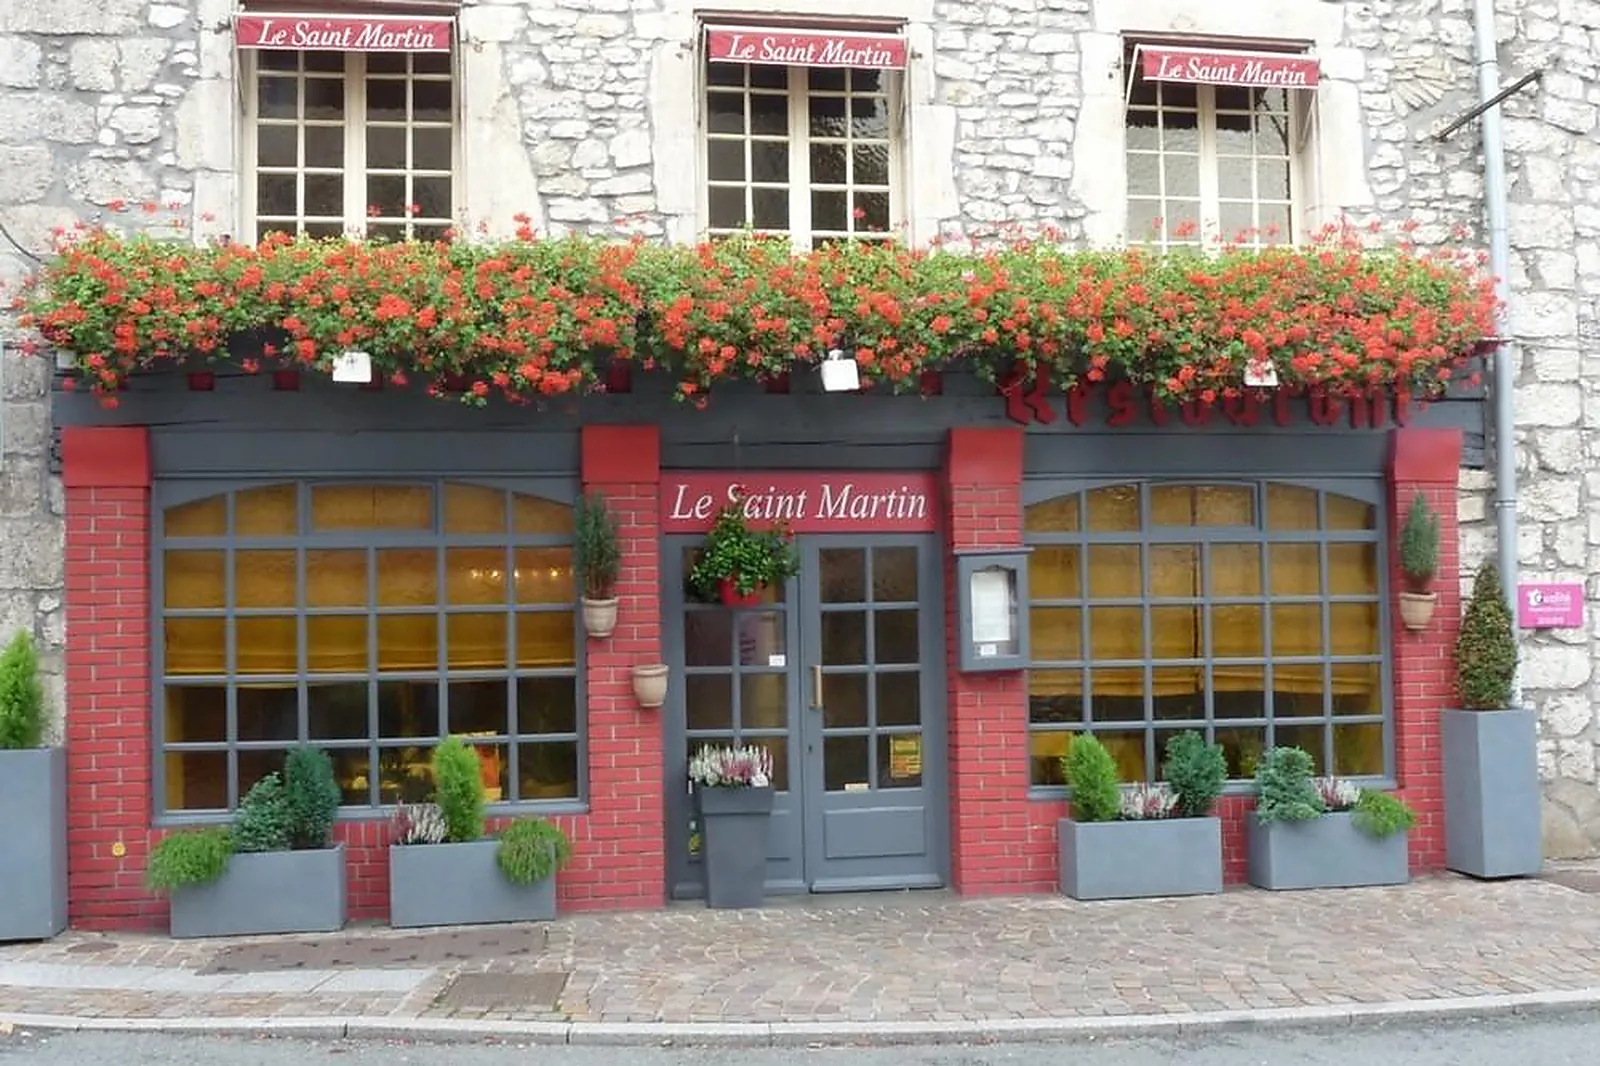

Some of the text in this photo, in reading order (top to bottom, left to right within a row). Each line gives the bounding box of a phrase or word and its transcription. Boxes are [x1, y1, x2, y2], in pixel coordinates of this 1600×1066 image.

[257, 20, 434, 48] Le Saint Martin
[728, 35, 892, 65] Le Saint Martin
[1159, 56, 1306, 85] Le Saint Martin
[669, 485, 713, 519] Le
[815, 483, 926, 519] Martin
